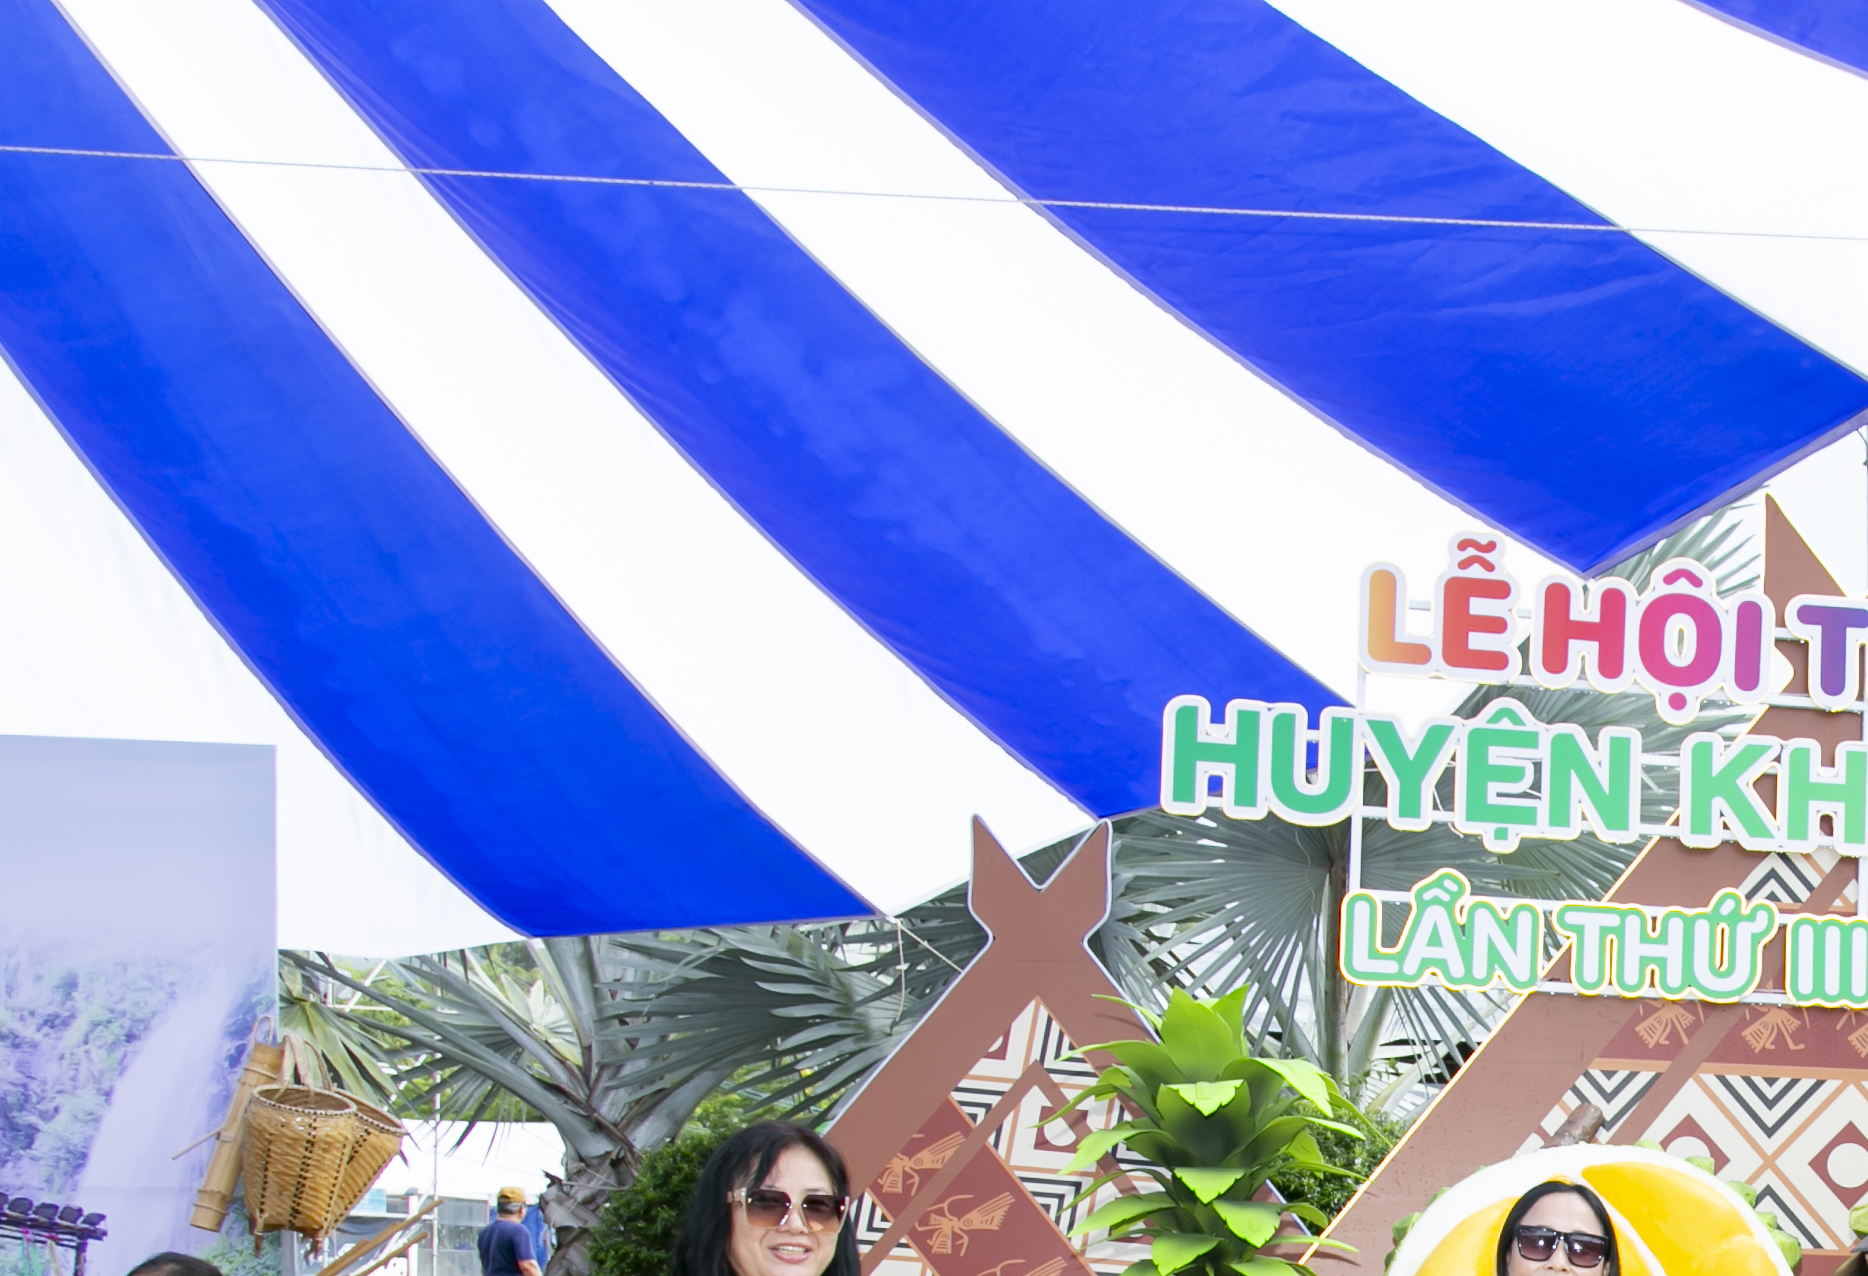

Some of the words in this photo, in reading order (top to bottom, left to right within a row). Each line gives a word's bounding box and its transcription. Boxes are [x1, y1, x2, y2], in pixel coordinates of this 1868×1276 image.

[1367, 537, 1512, 672] LỄ
[1541, 567, 1764, 712] HỘI
[1171, 704, 1632, 842] HUYỆN
[1352, 878, 1540, 983] LẦN
[1561, 898, 1770, 994] THỨ
[1797, 923, 1868, 999] III
